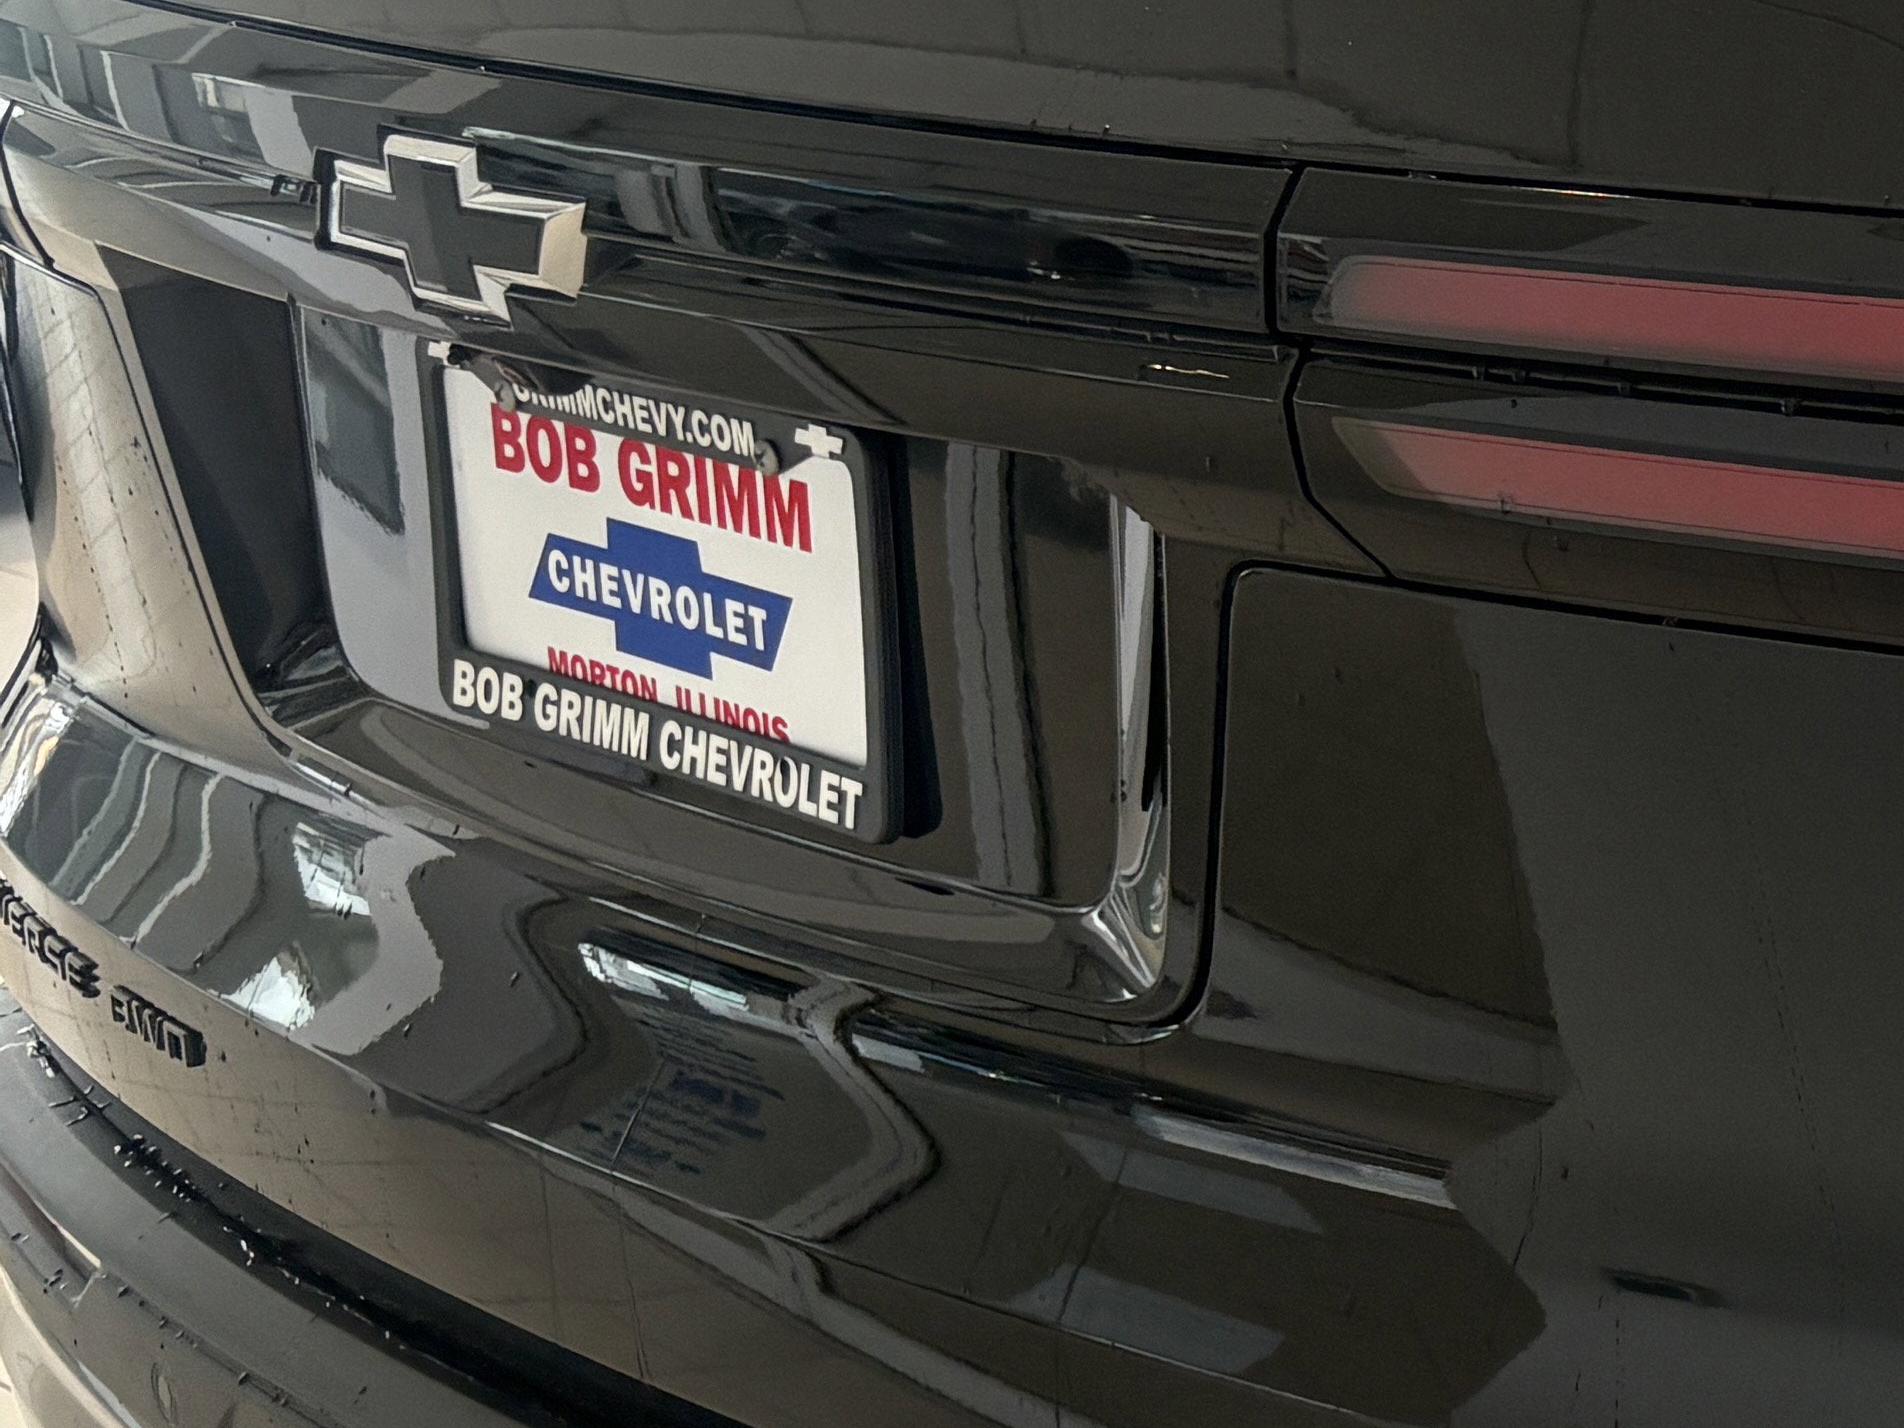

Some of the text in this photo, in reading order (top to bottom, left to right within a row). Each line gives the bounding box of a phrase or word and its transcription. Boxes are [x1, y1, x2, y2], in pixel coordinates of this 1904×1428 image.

[490, 403, 813, 553] BOB GRIMM
[547, 549, 767, 651] CHEVROLET
[548, 646, 658, 703] MORTON
[453, 658, 864, 829] BOB GRIMM CHEVROLET
